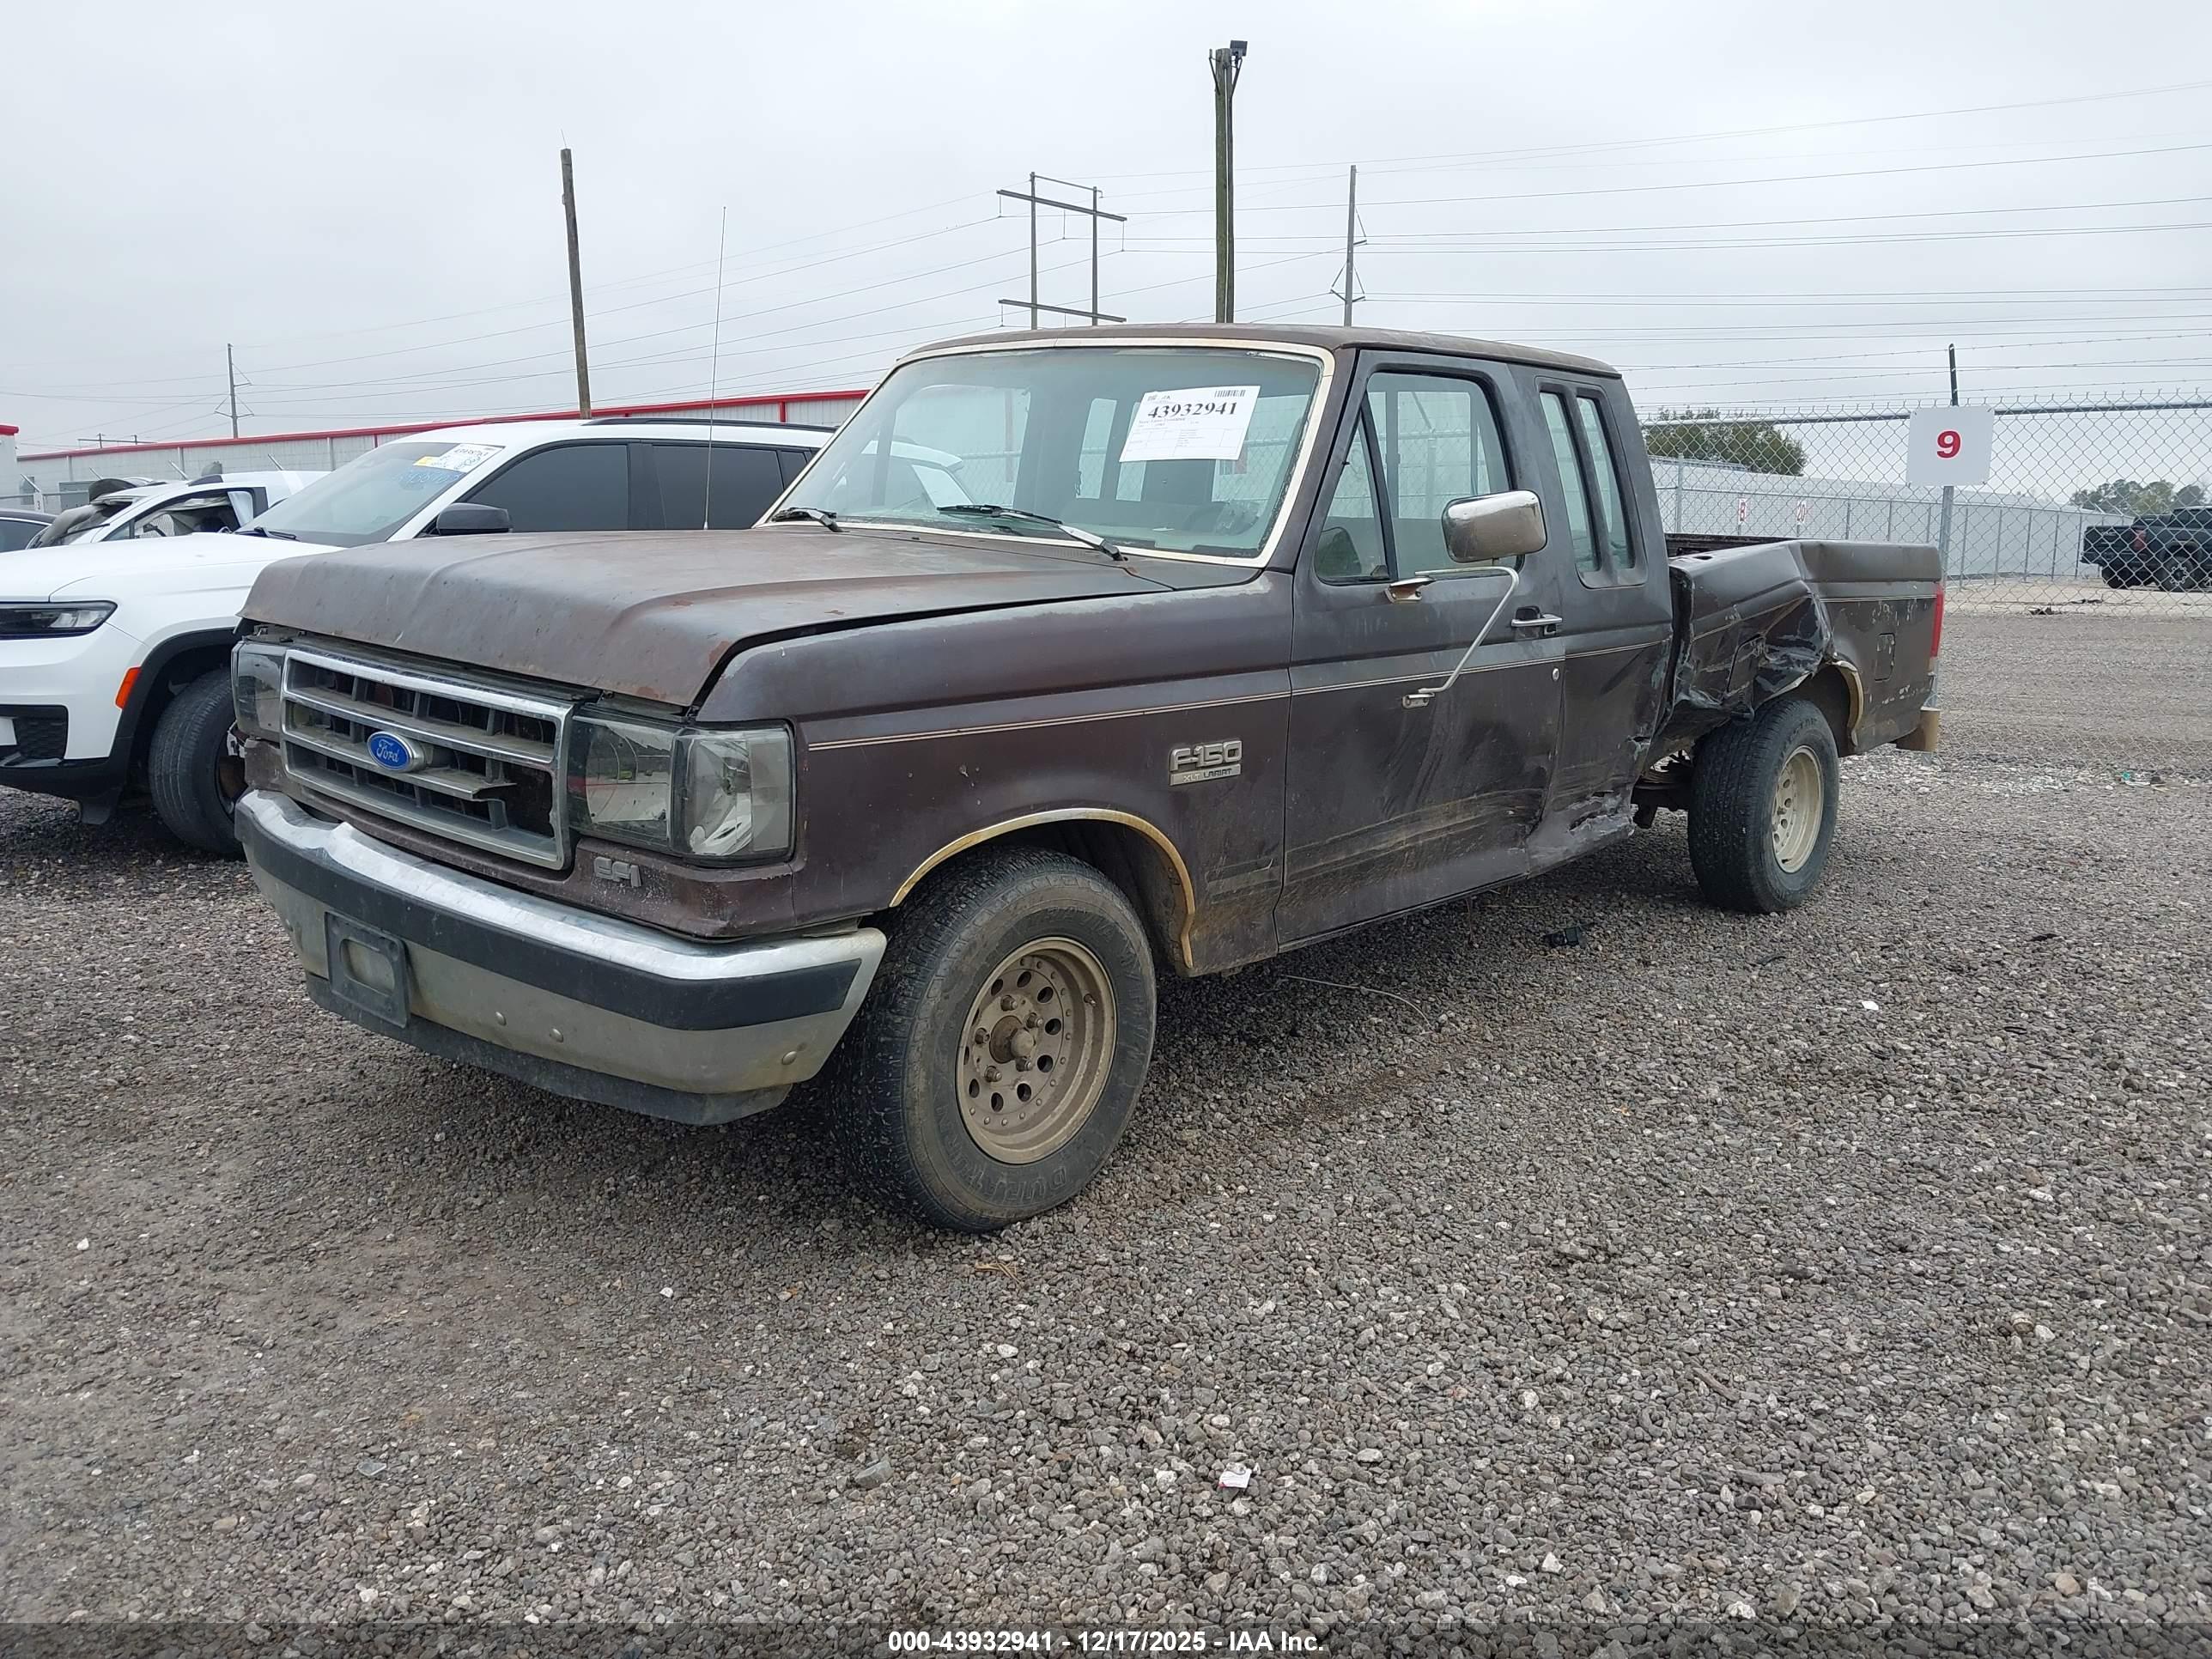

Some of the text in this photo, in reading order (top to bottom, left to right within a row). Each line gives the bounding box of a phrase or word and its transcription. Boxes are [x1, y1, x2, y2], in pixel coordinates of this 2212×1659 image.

[1147, 401, 1237, 418] 43932941
[1936, 430, 1961, 459] 9
[376, 738, 401, 763] Ford
[1170, 740, 1243, 772] F-150
[1183, 769, 1232, 782] XLT LARIAT
